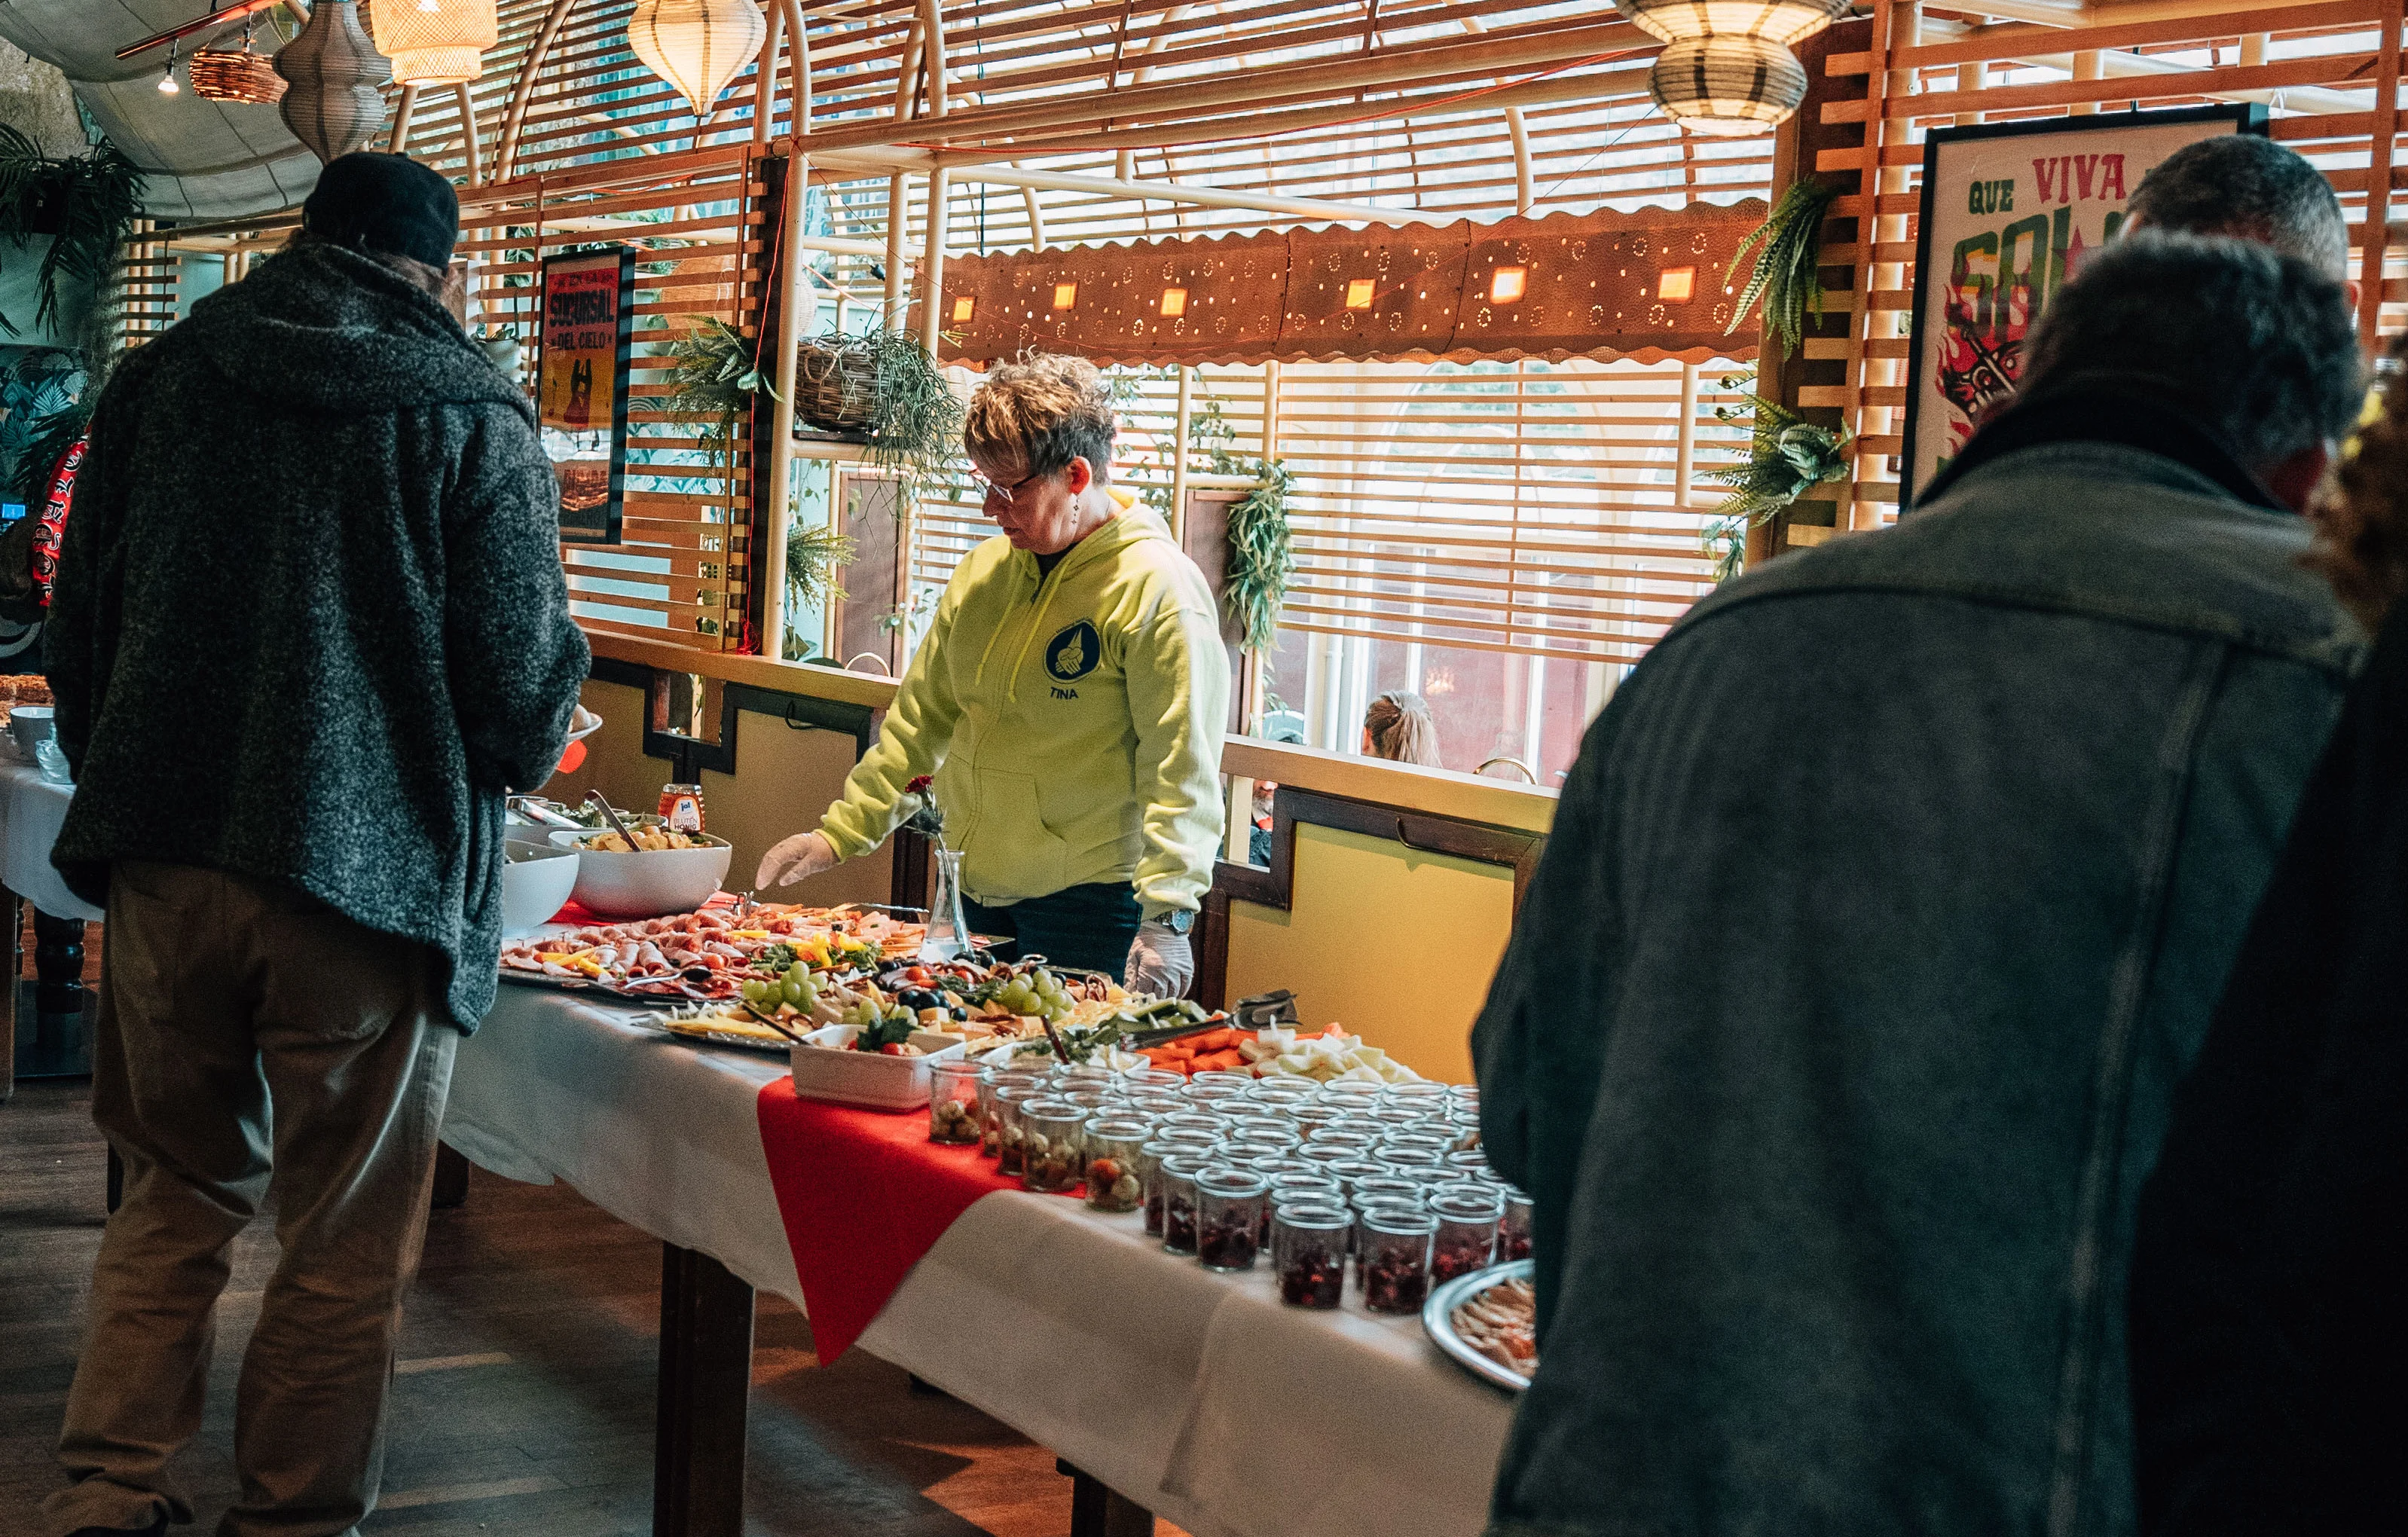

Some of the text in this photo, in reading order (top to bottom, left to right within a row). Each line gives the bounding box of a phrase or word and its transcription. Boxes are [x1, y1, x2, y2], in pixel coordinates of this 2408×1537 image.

[1968, 153, 2127, 216] QUE VIVA
[549, 288, 615, 328] SUCURSAL
[558, 332, 607, 350] DEL CIELO
[1050, 686, 1079, 700] TINA
